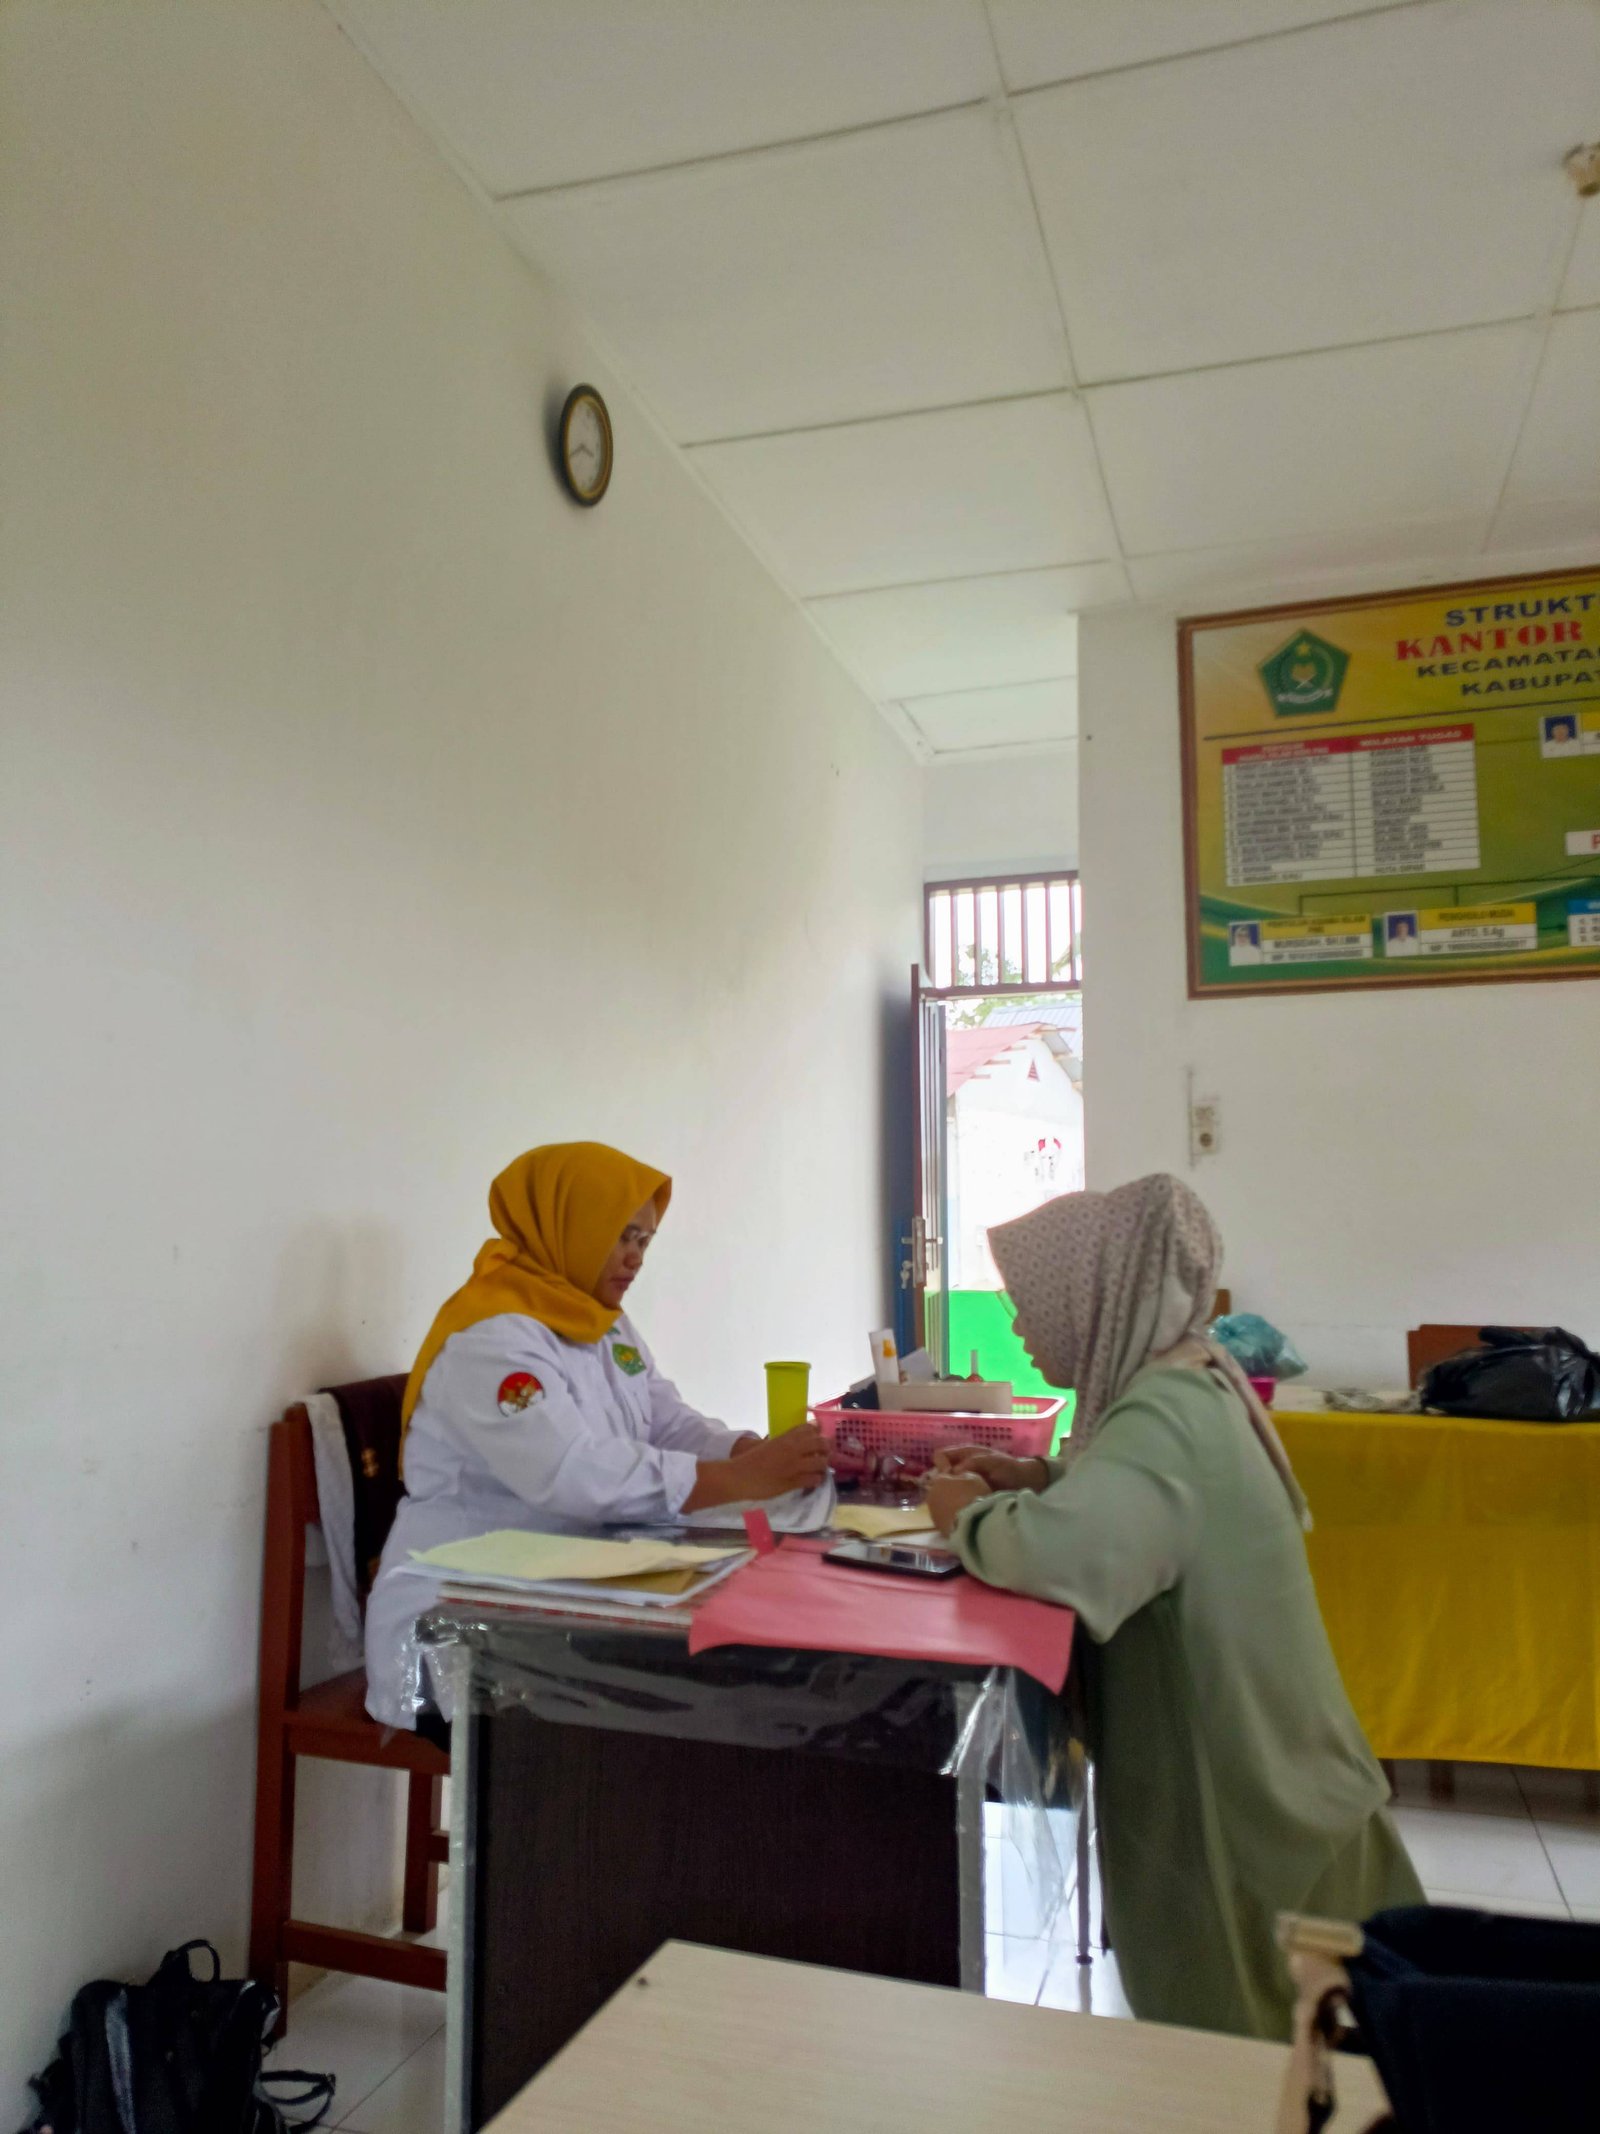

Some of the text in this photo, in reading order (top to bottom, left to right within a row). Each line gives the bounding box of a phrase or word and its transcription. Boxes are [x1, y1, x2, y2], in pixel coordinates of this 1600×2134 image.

[1446, 593, 1597, 627] STRUKT
[1396, 620, 1582, 660] KANTOR
[1417, 647, 1600, 678] KECAMATA
